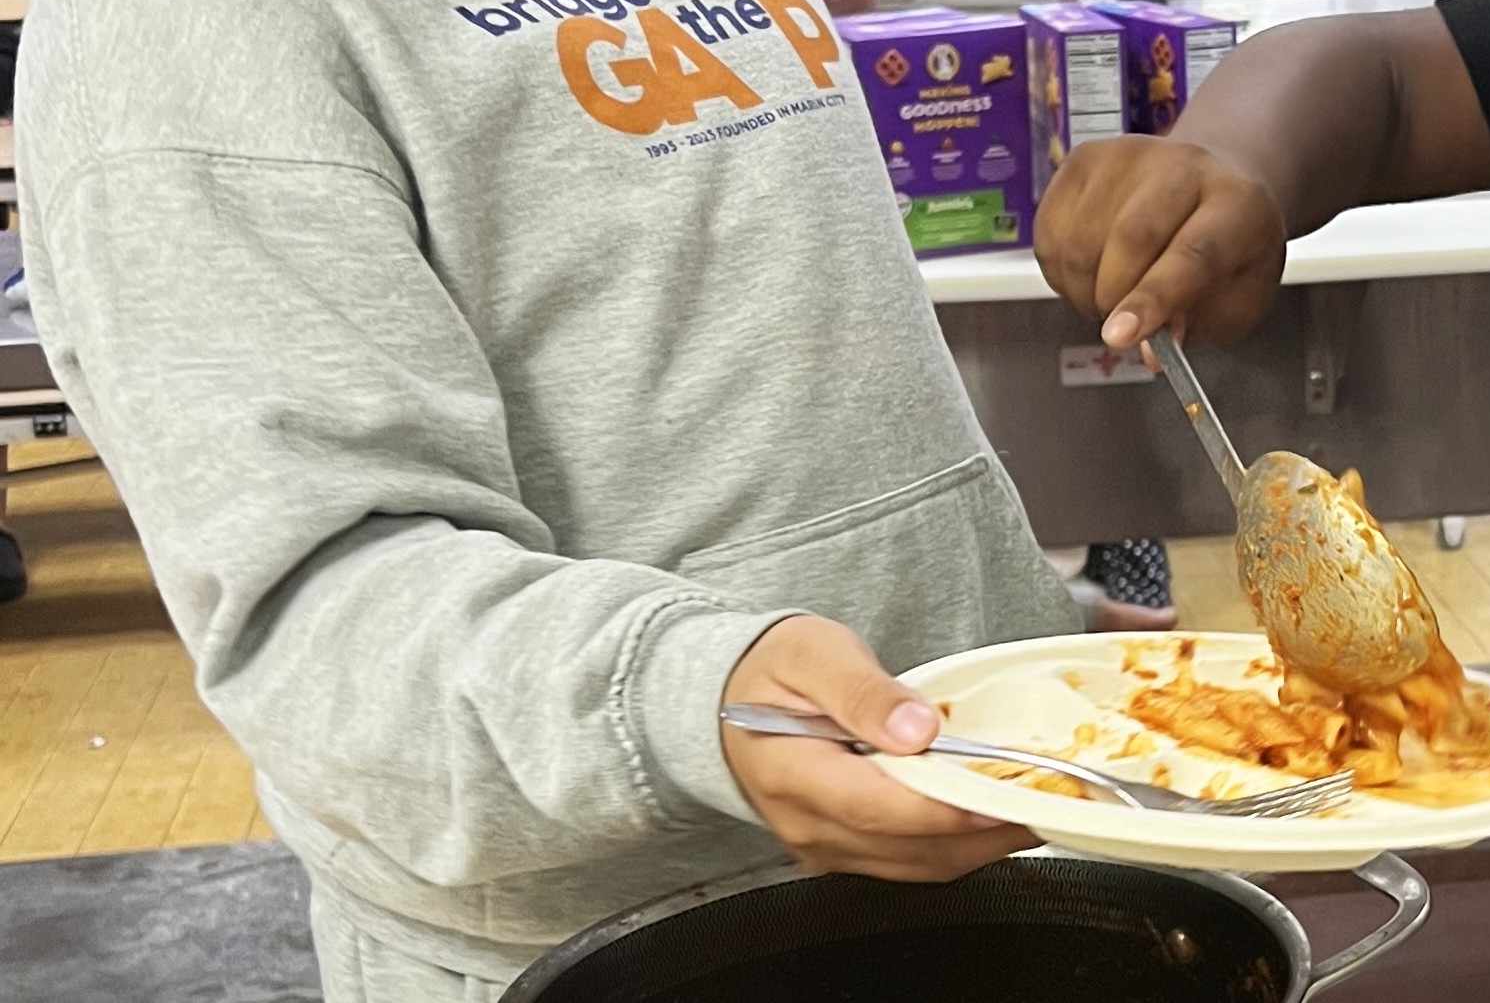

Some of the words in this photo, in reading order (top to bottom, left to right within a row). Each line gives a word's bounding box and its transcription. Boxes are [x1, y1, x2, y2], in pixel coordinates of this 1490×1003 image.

[645, 139, 678, 159] 1995
[716, 111, 776, 139] FOUNDED
[777, 105, 792, 119] IN
[792, 99, 826, 116] MARIN
